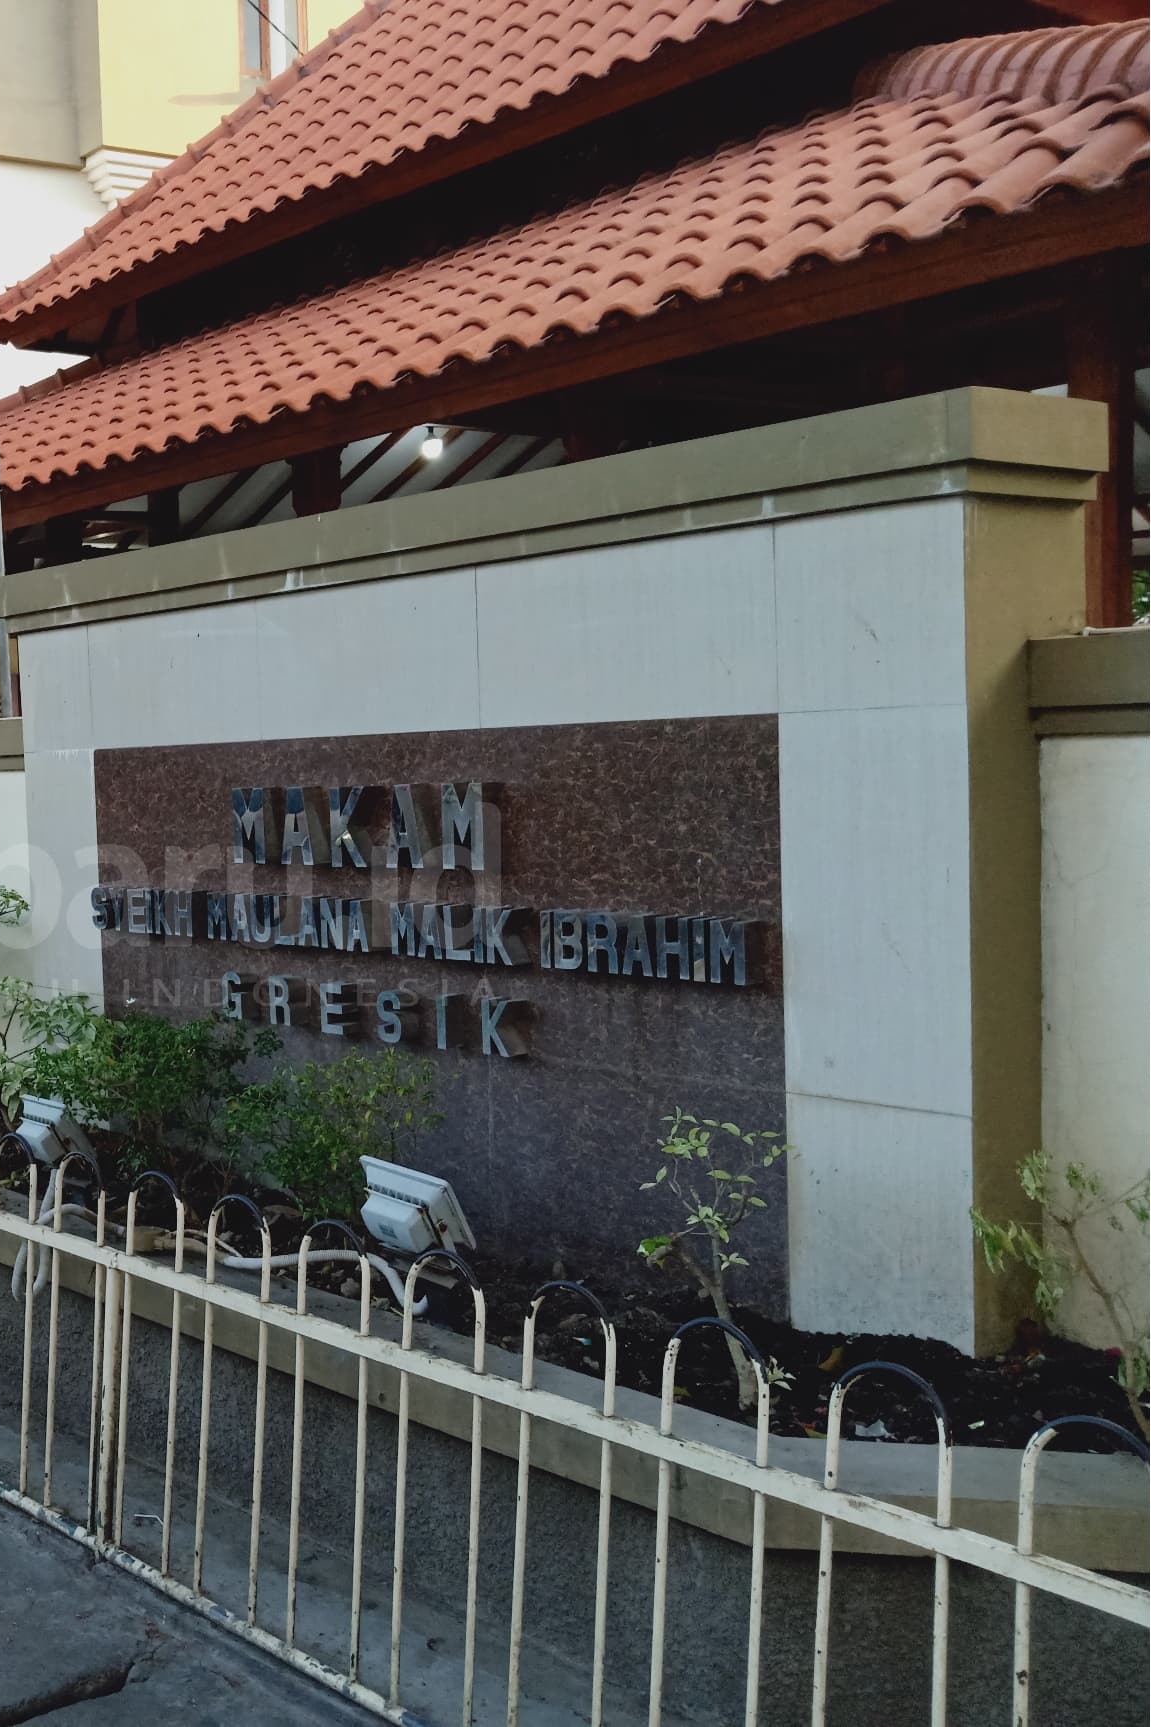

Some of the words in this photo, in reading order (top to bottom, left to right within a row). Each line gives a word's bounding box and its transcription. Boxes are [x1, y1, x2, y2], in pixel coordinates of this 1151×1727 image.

[232, 782, 488, 872] MAKAM
[92, 885, 196, 938] SYEIKH
[206, 892, 371, 954] MAULANA
[389, 902, 514, 966] MALIK
[540, 909, 748, 986] IBRAHIM
[220, 970, 512, 1058] GRESIK
